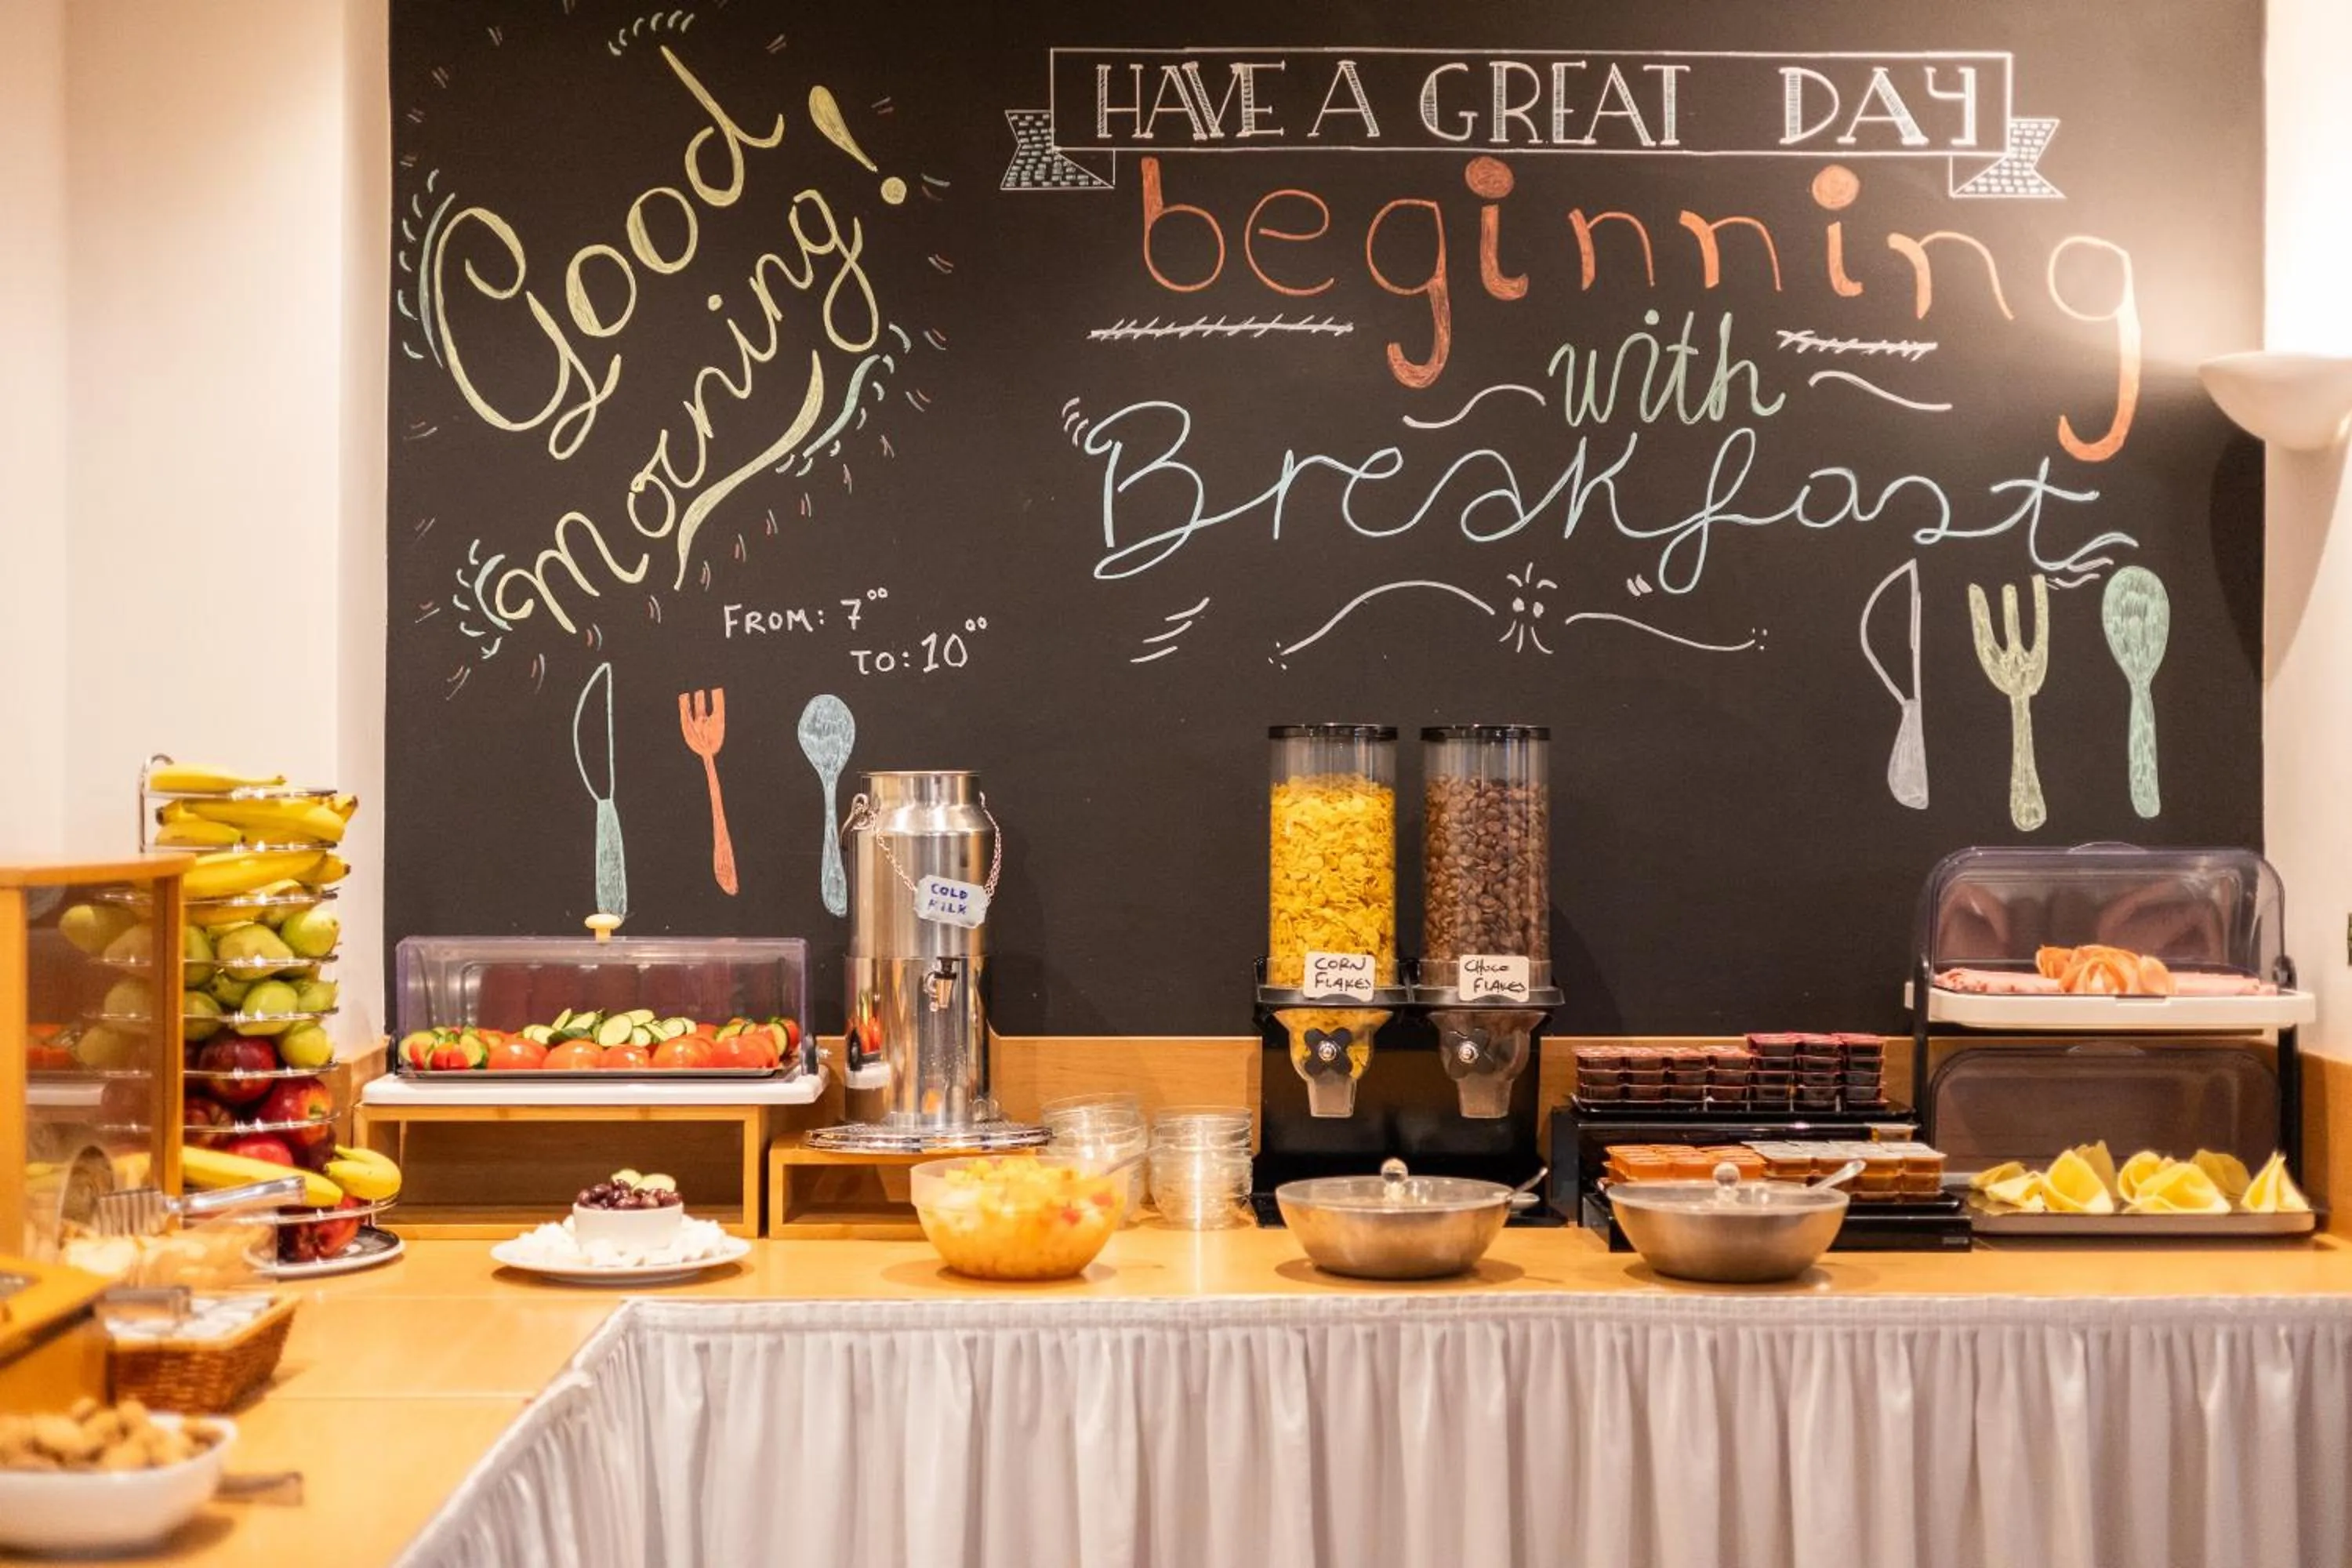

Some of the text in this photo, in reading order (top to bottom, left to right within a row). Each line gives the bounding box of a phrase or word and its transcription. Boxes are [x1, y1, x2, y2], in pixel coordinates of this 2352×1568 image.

[1096, 60, 1979, 147] HAVE A GREAT DAY
[434, 45, 785, 460] Good
[1141, 157, 2143, 463] beginning
[1548, 309, 1787, 427] with
[1084, 401, 2139, 595] Breakfast
[723, 603, 825, 639] FROM:
[849, 649, 911, 675] TO:
[931, 883, 968, 900] COLD
[1314, 956, 1367, 971] CORN
